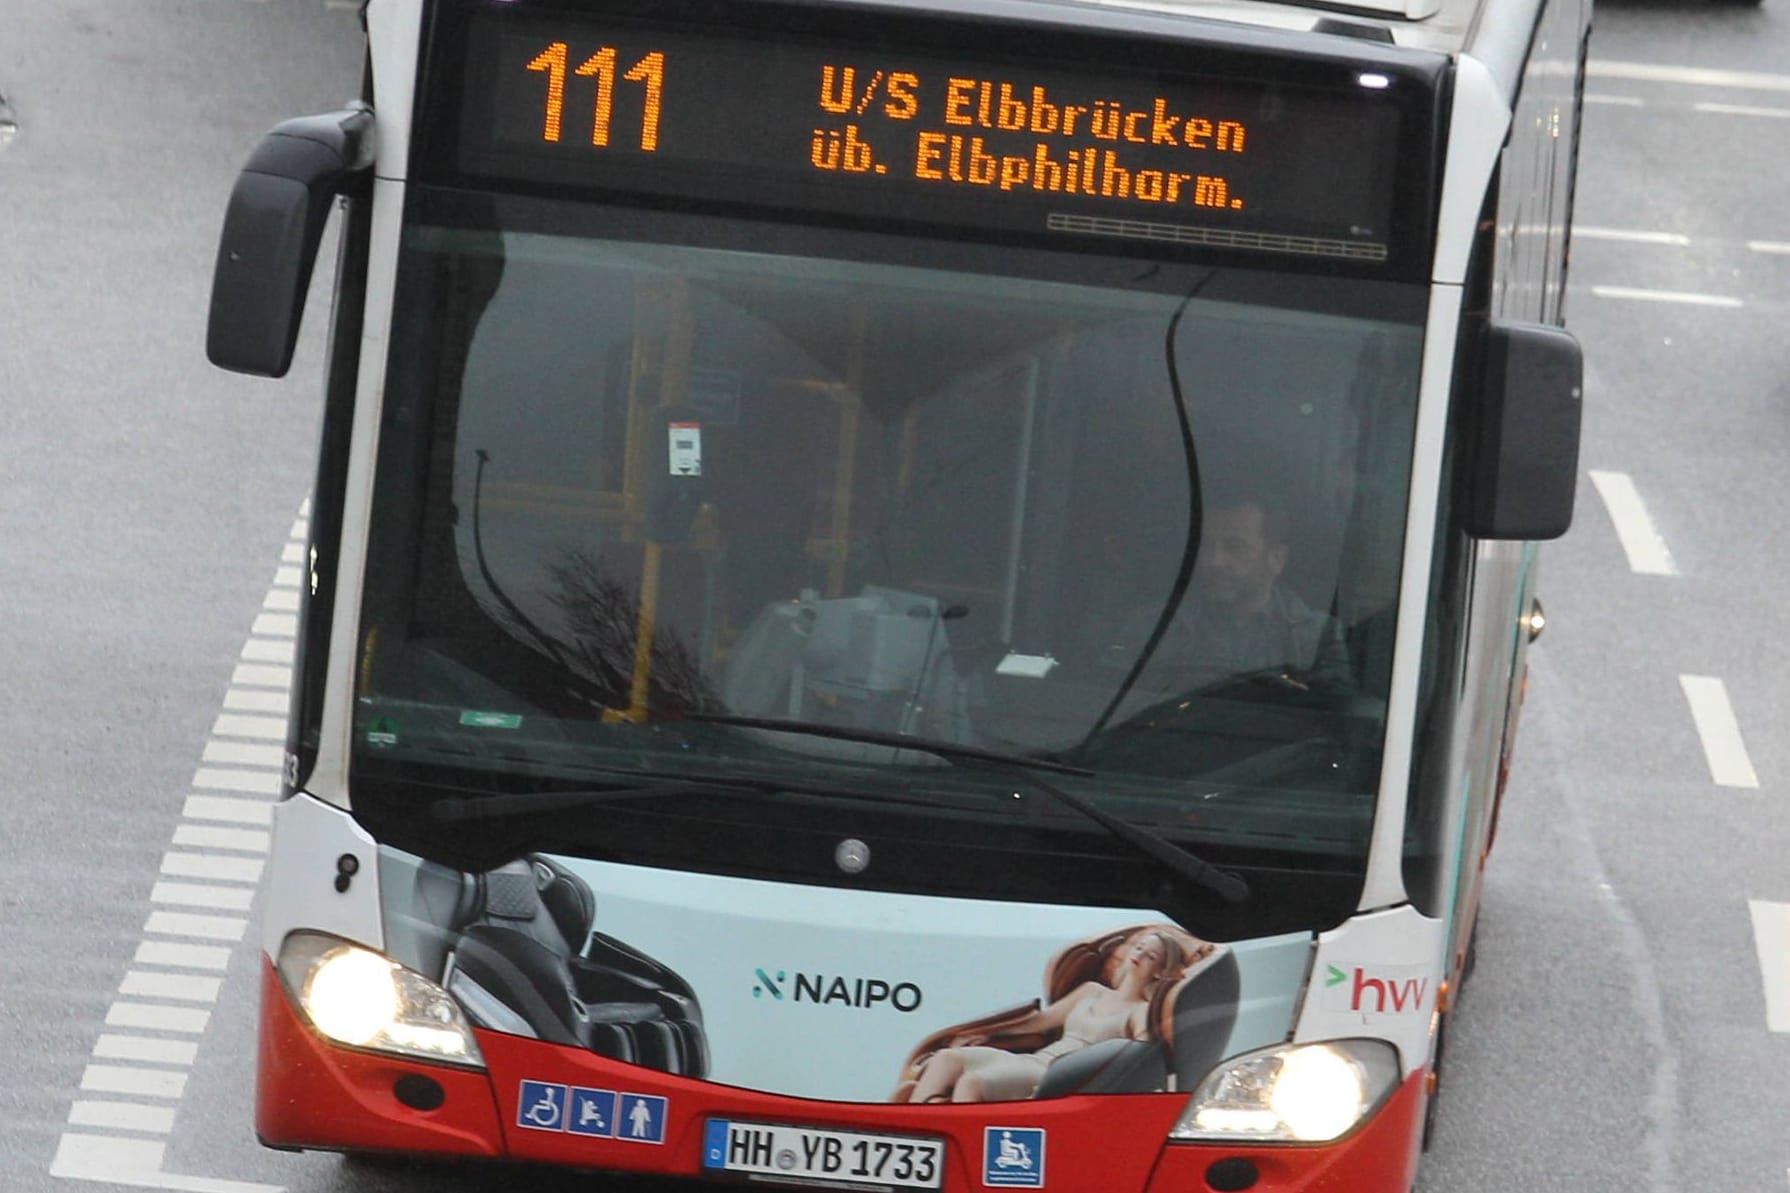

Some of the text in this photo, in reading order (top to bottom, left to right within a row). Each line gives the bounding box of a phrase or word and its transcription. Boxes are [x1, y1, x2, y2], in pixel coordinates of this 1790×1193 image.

[526, 42, 664, 151] 111
[820, 65, 1246, 152] U/S Elbbrücken
[811, 125, 1243, 209] üb. Elbphilharm.
[794, 972, 922, 1012] NAIPO
[729, 1129, 773, 1167] HH
[802, 1134, 842, 1173] YB
[851, 1140, 937, 1182] 1733
